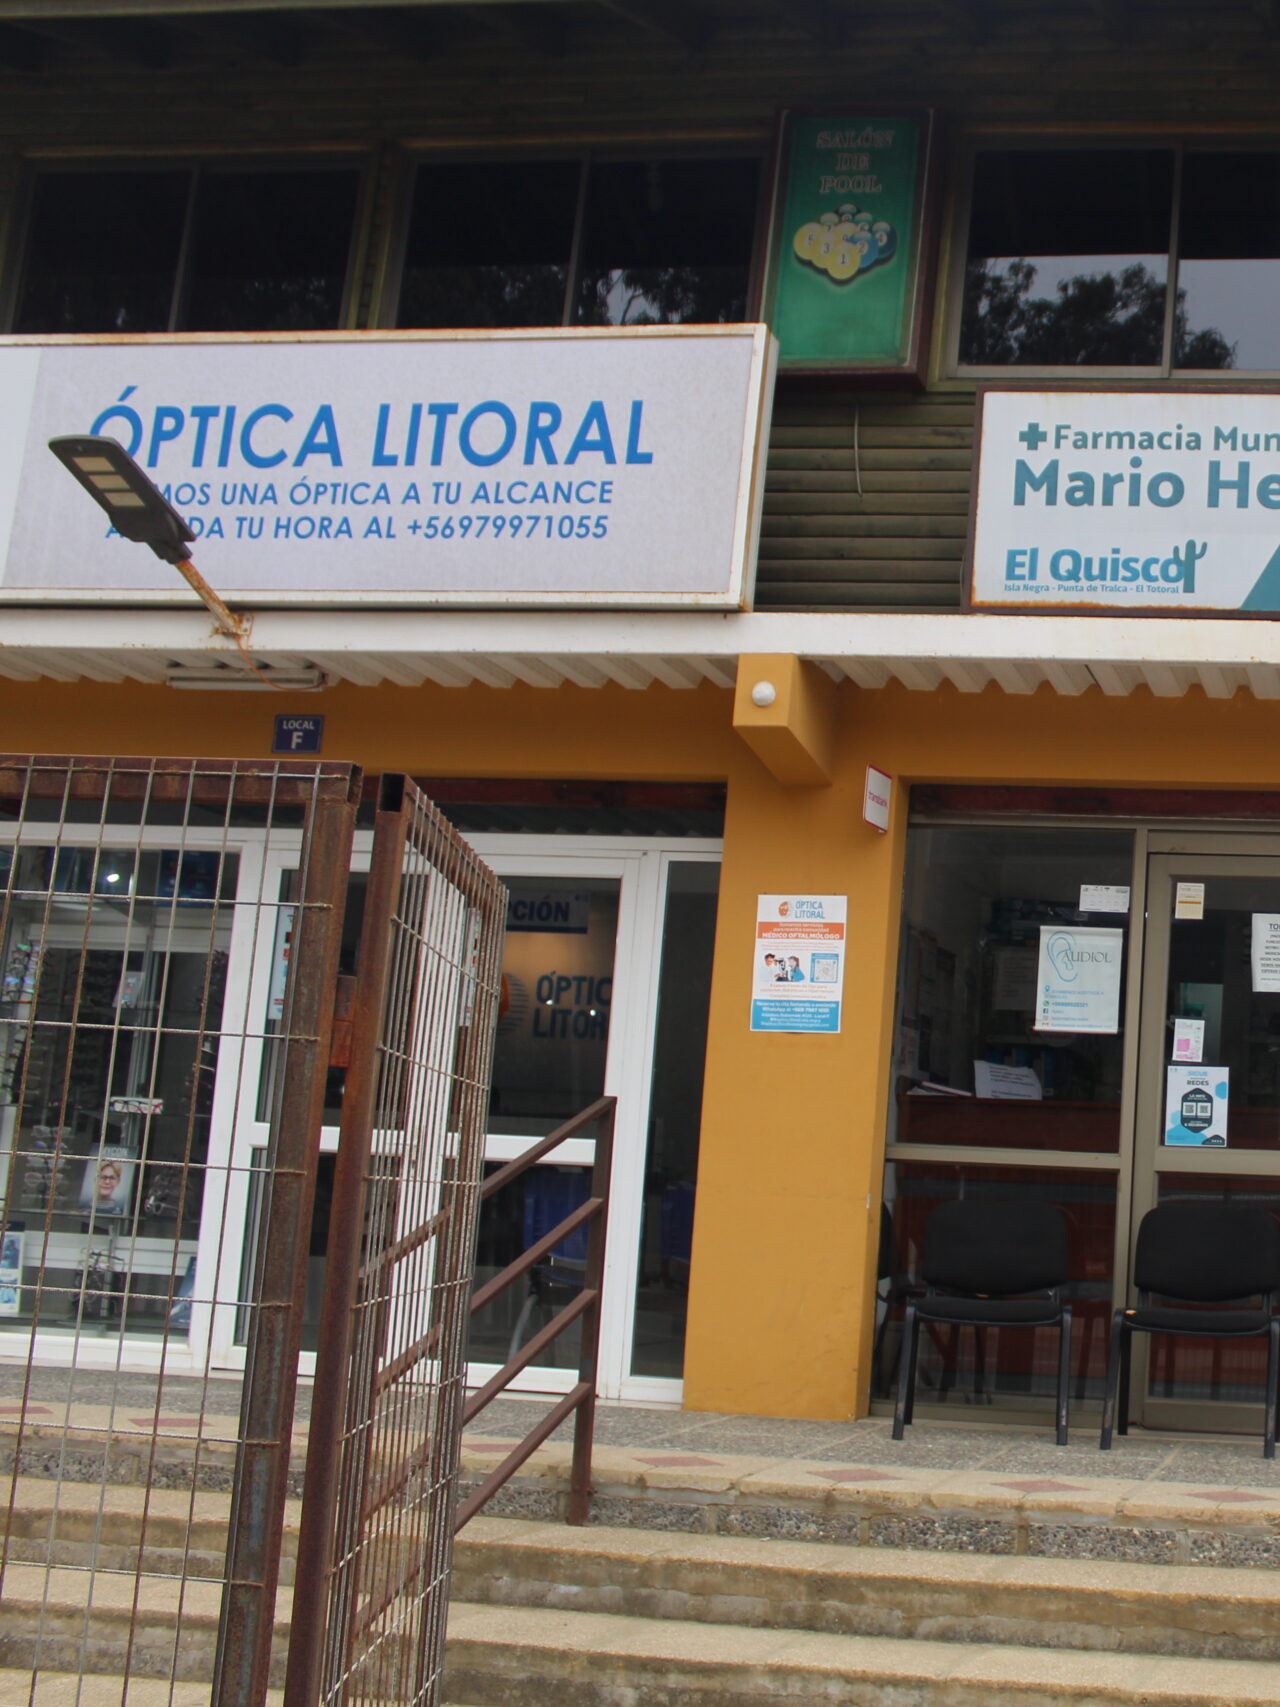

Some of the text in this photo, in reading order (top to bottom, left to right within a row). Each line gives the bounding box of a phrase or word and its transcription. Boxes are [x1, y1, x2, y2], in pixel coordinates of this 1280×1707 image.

[816, 126, 895, 149] SALÓN
[836, 153, 869, 171] DE
[819, 175, 882, 194] POOL
[372, 400, 655, 468] LITORAL
[1054, 424, 1201, 451] Farmacia
[221, 482, 279, 506] UNA
[289, 475, 393, 506] ÓPTICA
[400, 482, 423, 505] A
[432, 481, 463, 505] TU
[471, 480, 613, 505] ALCANCE
[1013, 456, 1186, 508] Mario
[235, 515, 267, 540] TU
[273, 516, 354, 540] HORA
[363, 516, 397, 539] AL
[406, 515, 609, 540] +56979971055
[1005, 547, 1188, 584] El Quisco
[1004, 583, 1179, 595] Isla Negra Punta de Tralca El Totoral
[282, 720, 314, 731] LOCAL
[290, 732, 304, 750] F
[795, 910, 826, 919] LITORAL
[536, 970, 612, 1006] ÓPTIC
